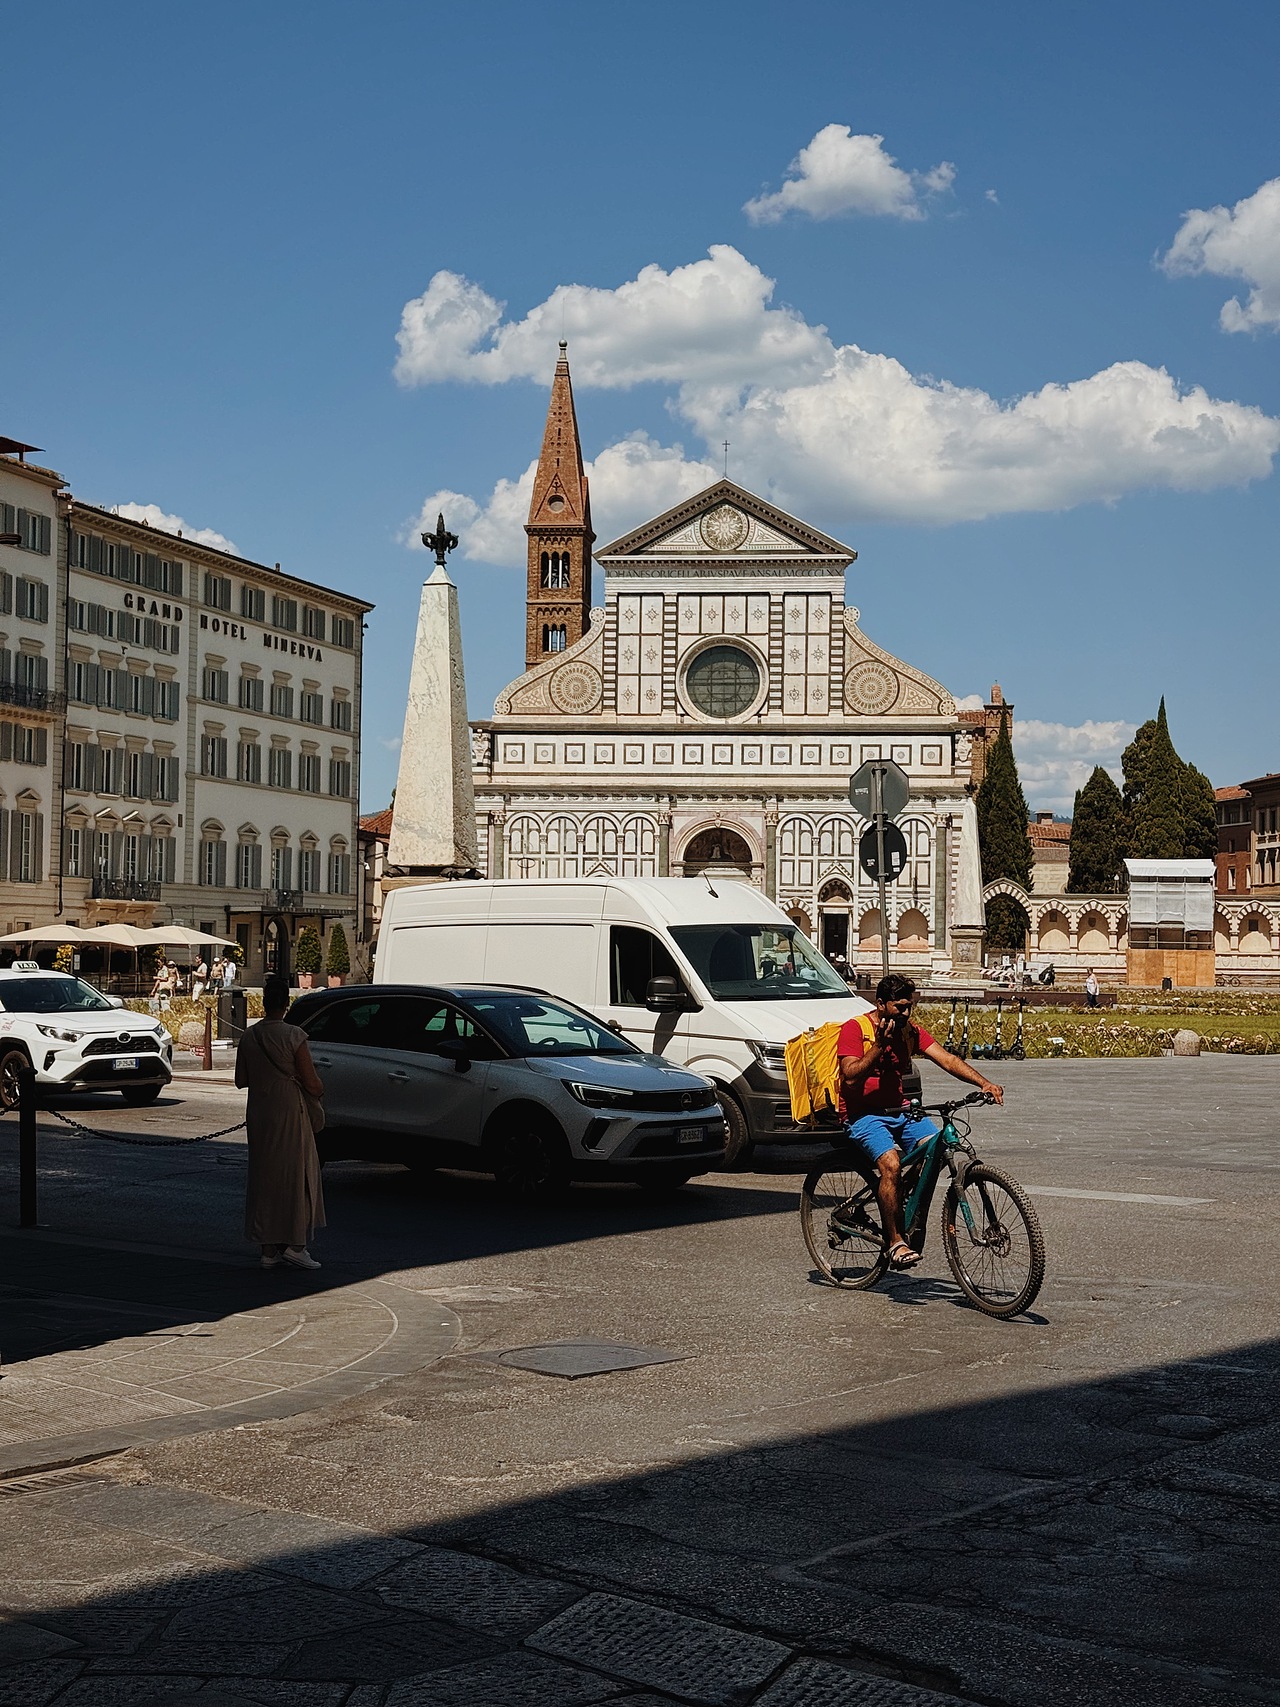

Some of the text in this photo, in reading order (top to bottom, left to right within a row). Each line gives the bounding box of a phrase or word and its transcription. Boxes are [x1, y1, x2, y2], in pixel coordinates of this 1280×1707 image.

[124, 592, 323, 662] GRAND HOTEL MINERVA
